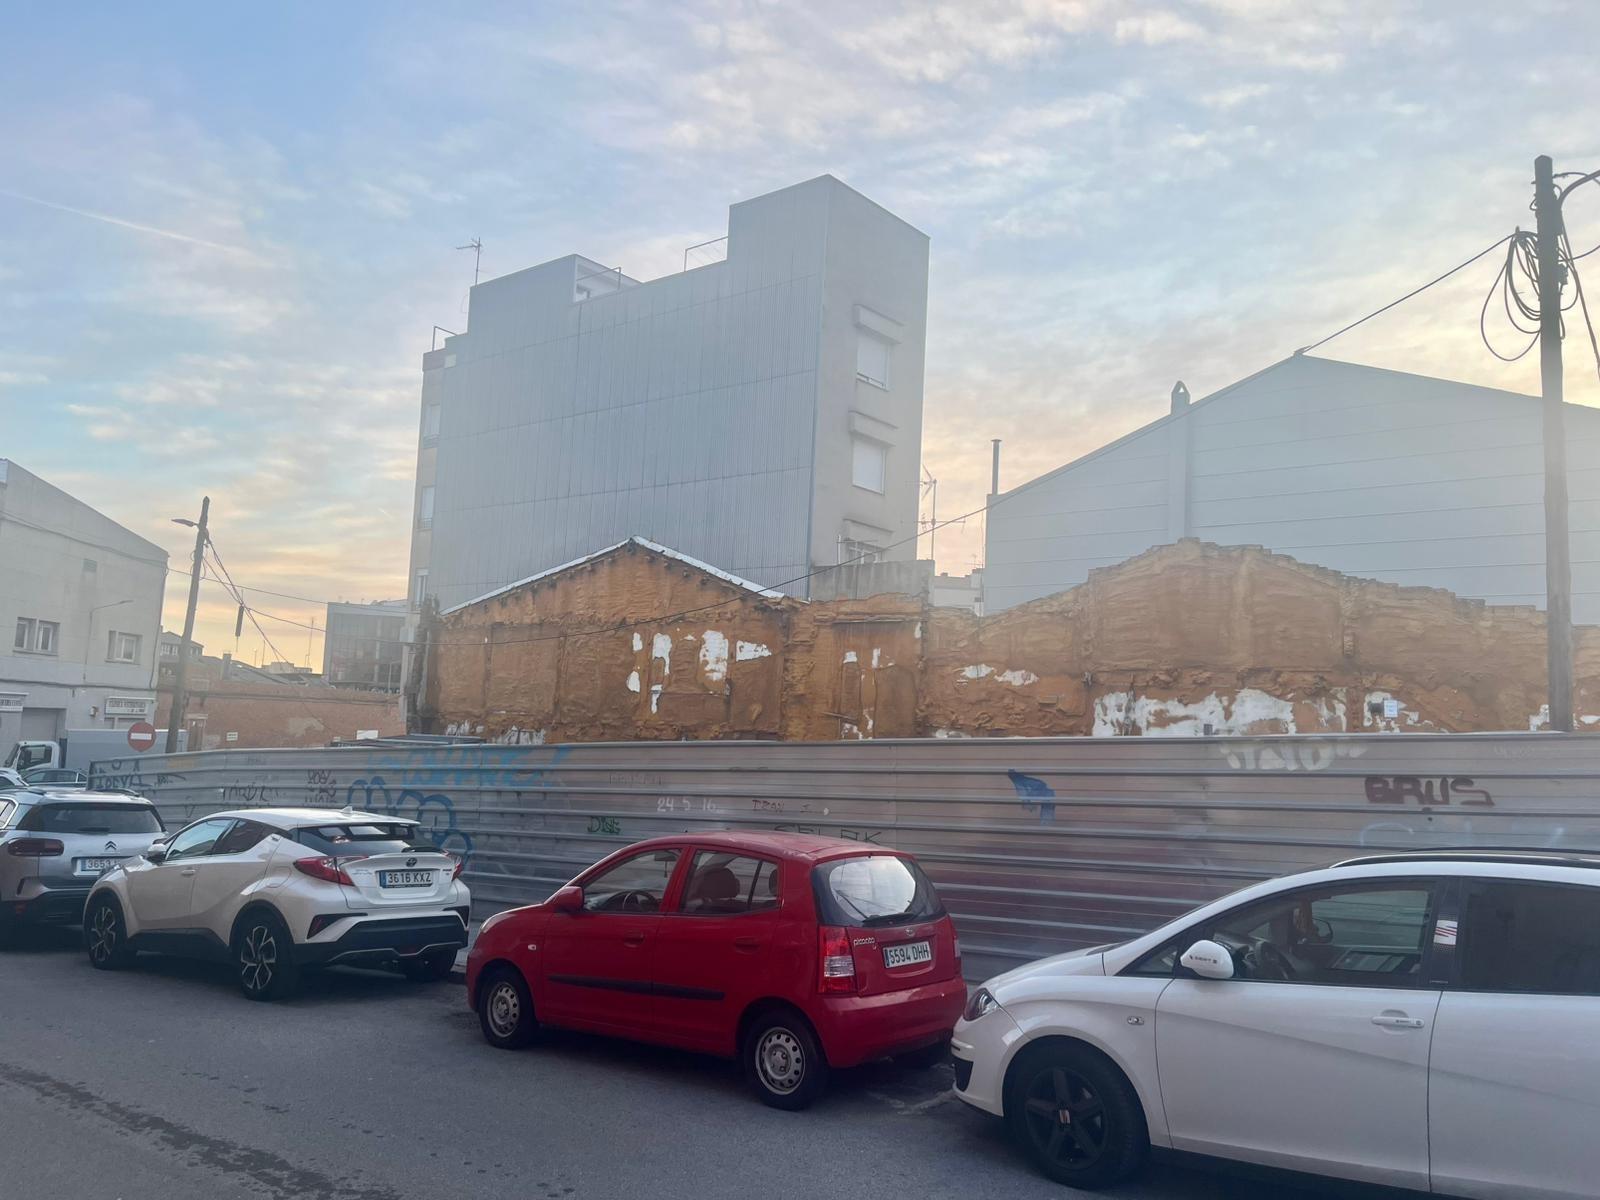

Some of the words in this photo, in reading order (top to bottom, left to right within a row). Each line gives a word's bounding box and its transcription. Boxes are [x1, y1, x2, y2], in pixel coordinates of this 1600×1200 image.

[1365, 775, 1495, 807] BRUS
[657, 797, 675, 812] 24
[388, 873, 411, 883] 3616
[889, 949, 912, 964] 5594
[912, 945, 930, 959] DHH
